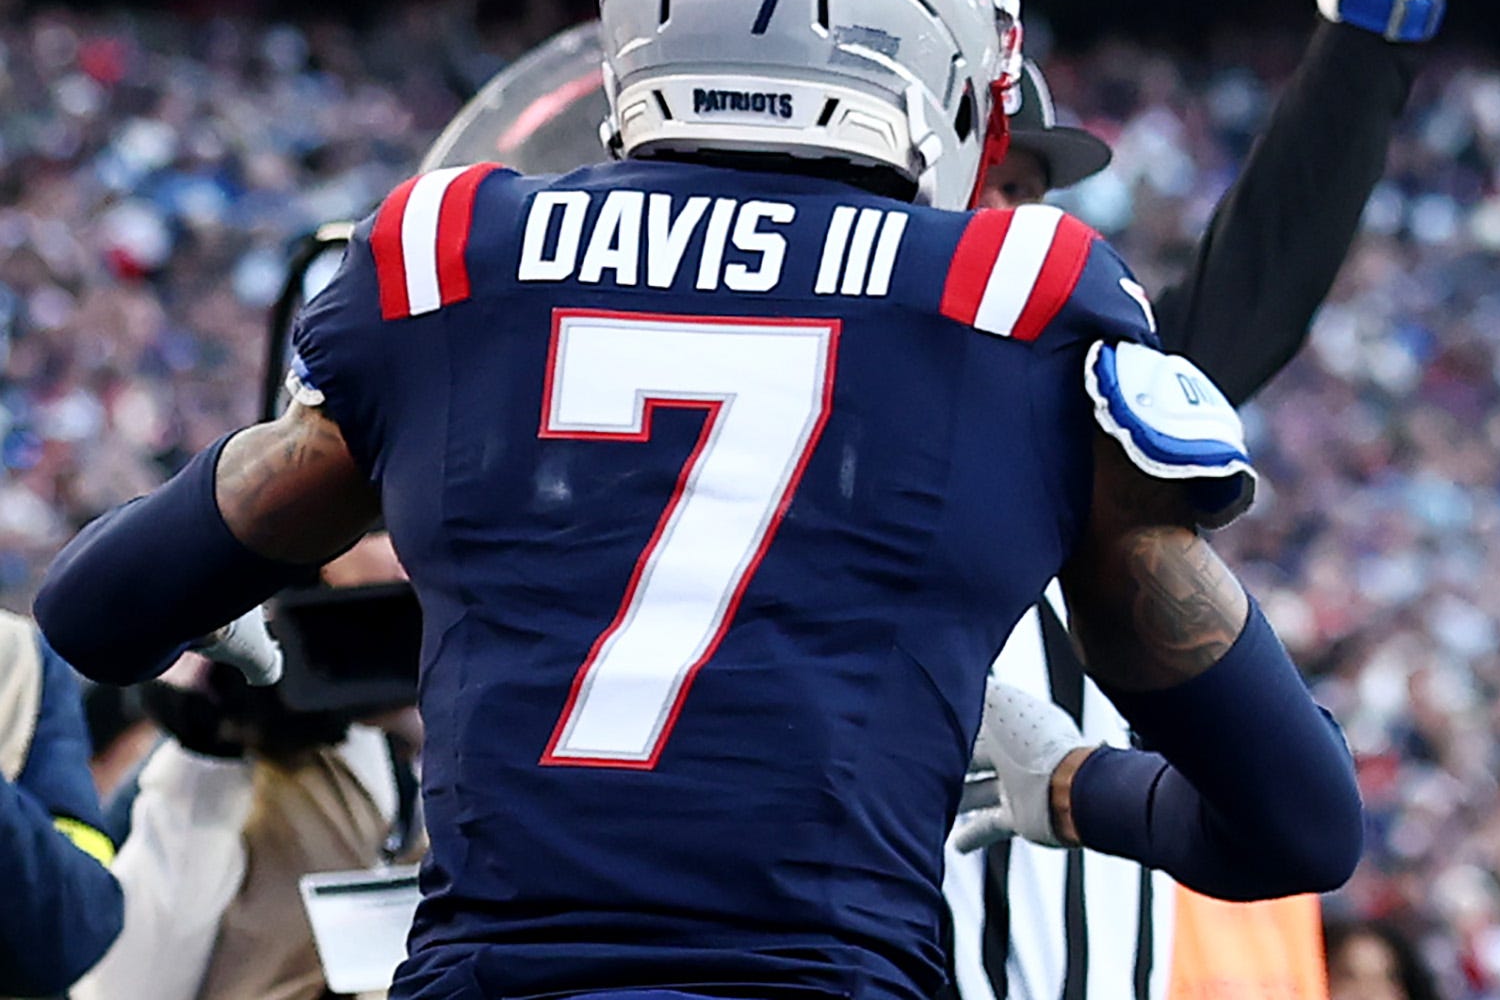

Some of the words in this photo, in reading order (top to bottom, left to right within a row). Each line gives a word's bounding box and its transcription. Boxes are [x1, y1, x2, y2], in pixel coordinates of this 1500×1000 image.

[693, 88, 793, 119] PATRIOTS
[518, 190, 796, 292] DAVIS
[814, 206, 908, 296] III
[538, 307, 842, 770] 7
